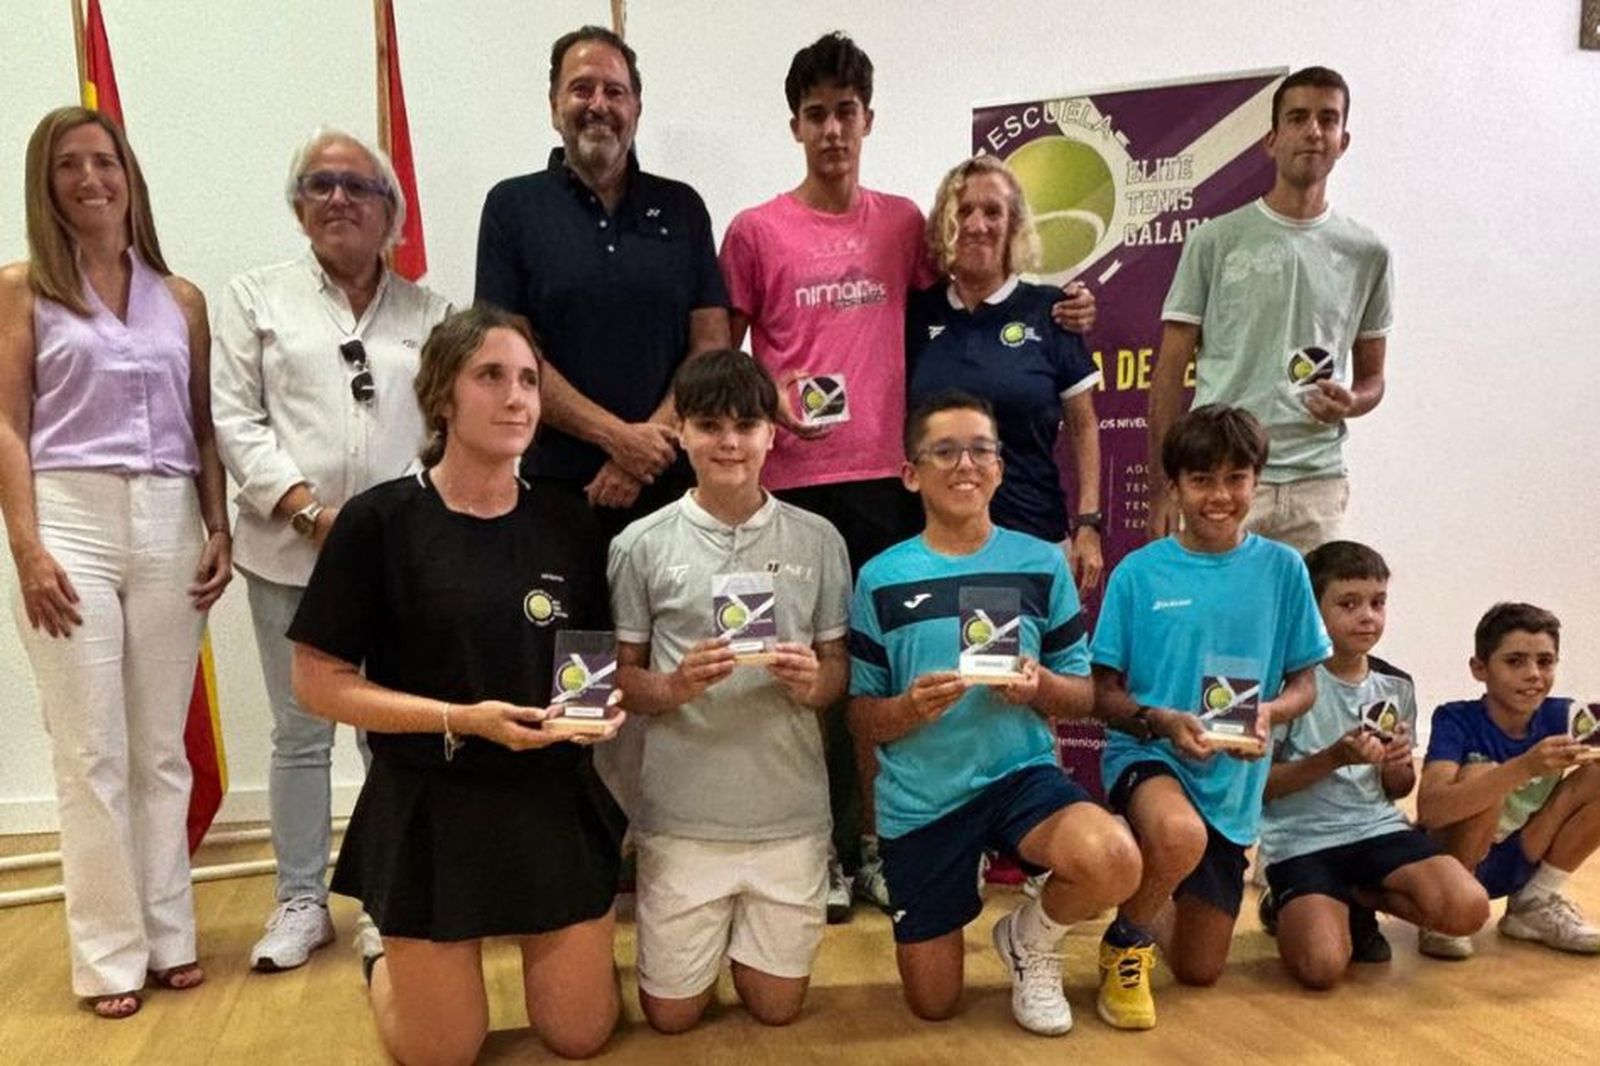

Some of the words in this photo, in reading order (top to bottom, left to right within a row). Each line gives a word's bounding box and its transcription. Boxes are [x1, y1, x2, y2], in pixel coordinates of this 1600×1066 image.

[986, 97, 1115, 151] ESCUELA
[1126, 155, 1194, 184] ELITE
[1125, 187, 1193, 215] TENIS
[1116, 349, 1153, 391] DE
[1117, 417, 1149, 428] NIVEL
